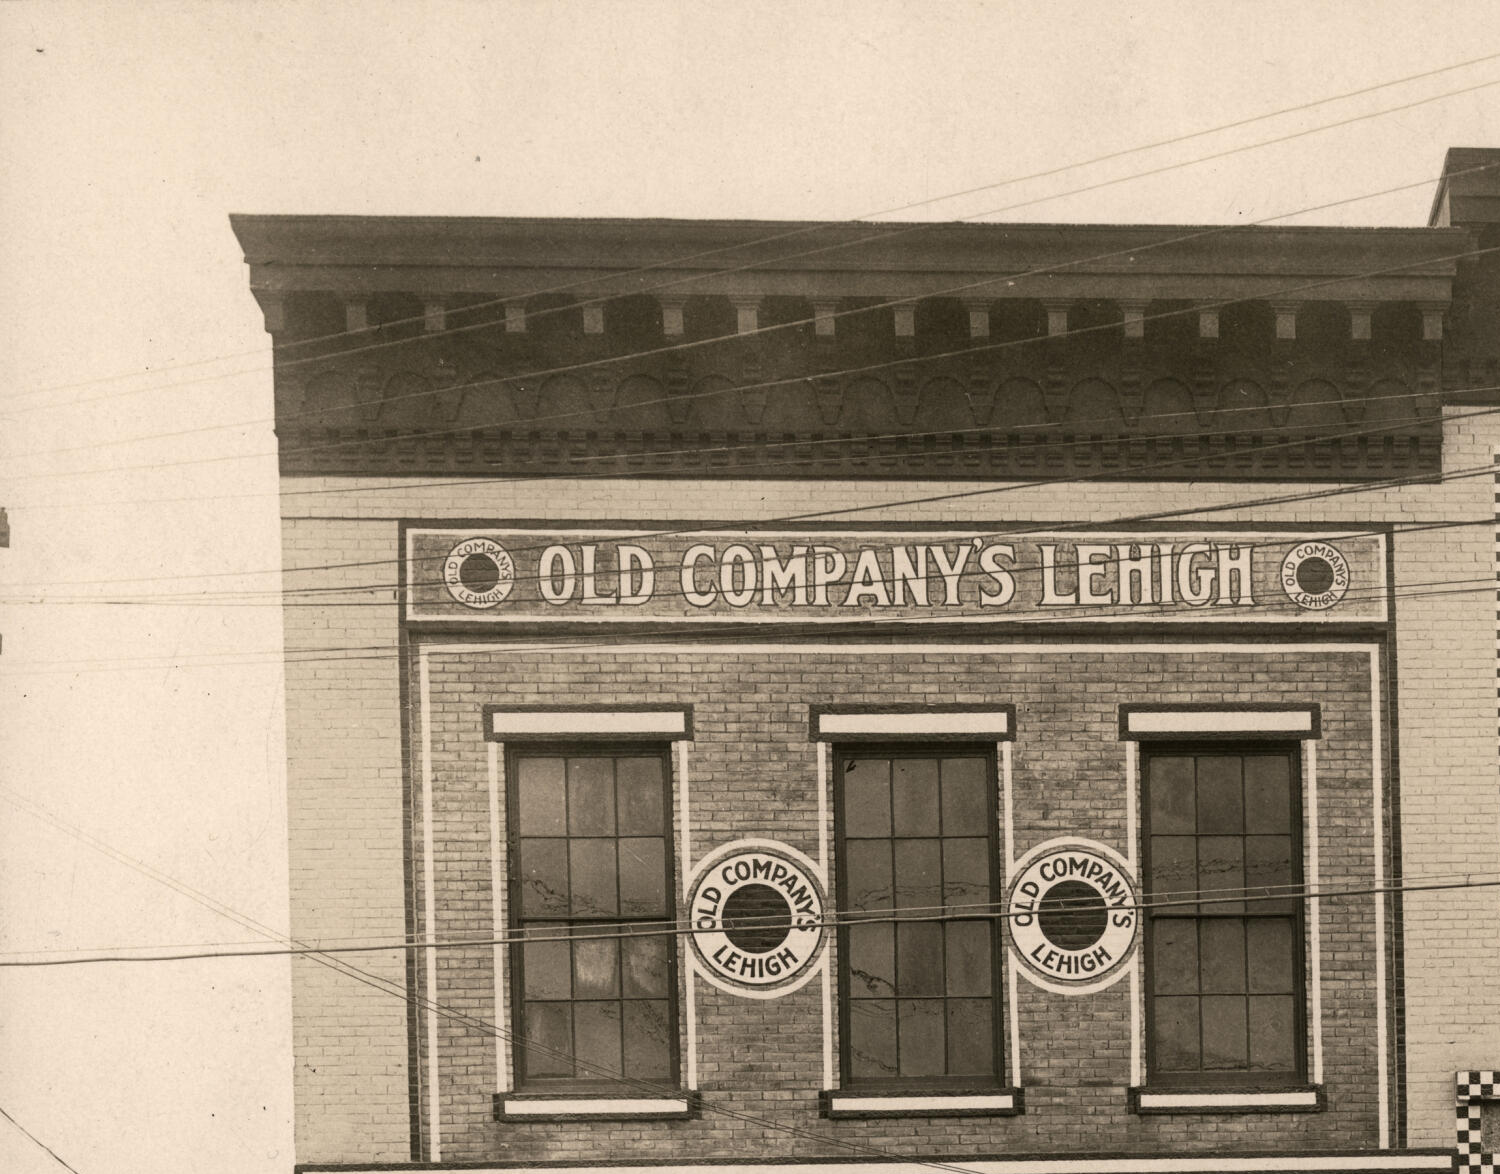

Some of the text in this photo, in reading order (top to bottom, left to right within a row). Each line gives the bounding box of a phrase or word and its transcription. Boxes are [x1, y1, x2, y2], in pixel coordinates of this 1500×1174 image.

[448, 561, 459, 585] OLD
[537, 537, 1256, 608] OLD COMPANY'S LEHIGH
[1285, 561, 1296, 587] OLD
[458, 588, 504, 605] LEHIGH
[1295, 590, 1338, 607] LEHIGH
[697, 858, 821, 933] OLD COMPANY'S
[1014, 857, 1135, 929] OLD COMPANY'S
[712, 944, 799, 978] LEHIGH
[1030, 943, 1113, 975] LEHIGH
